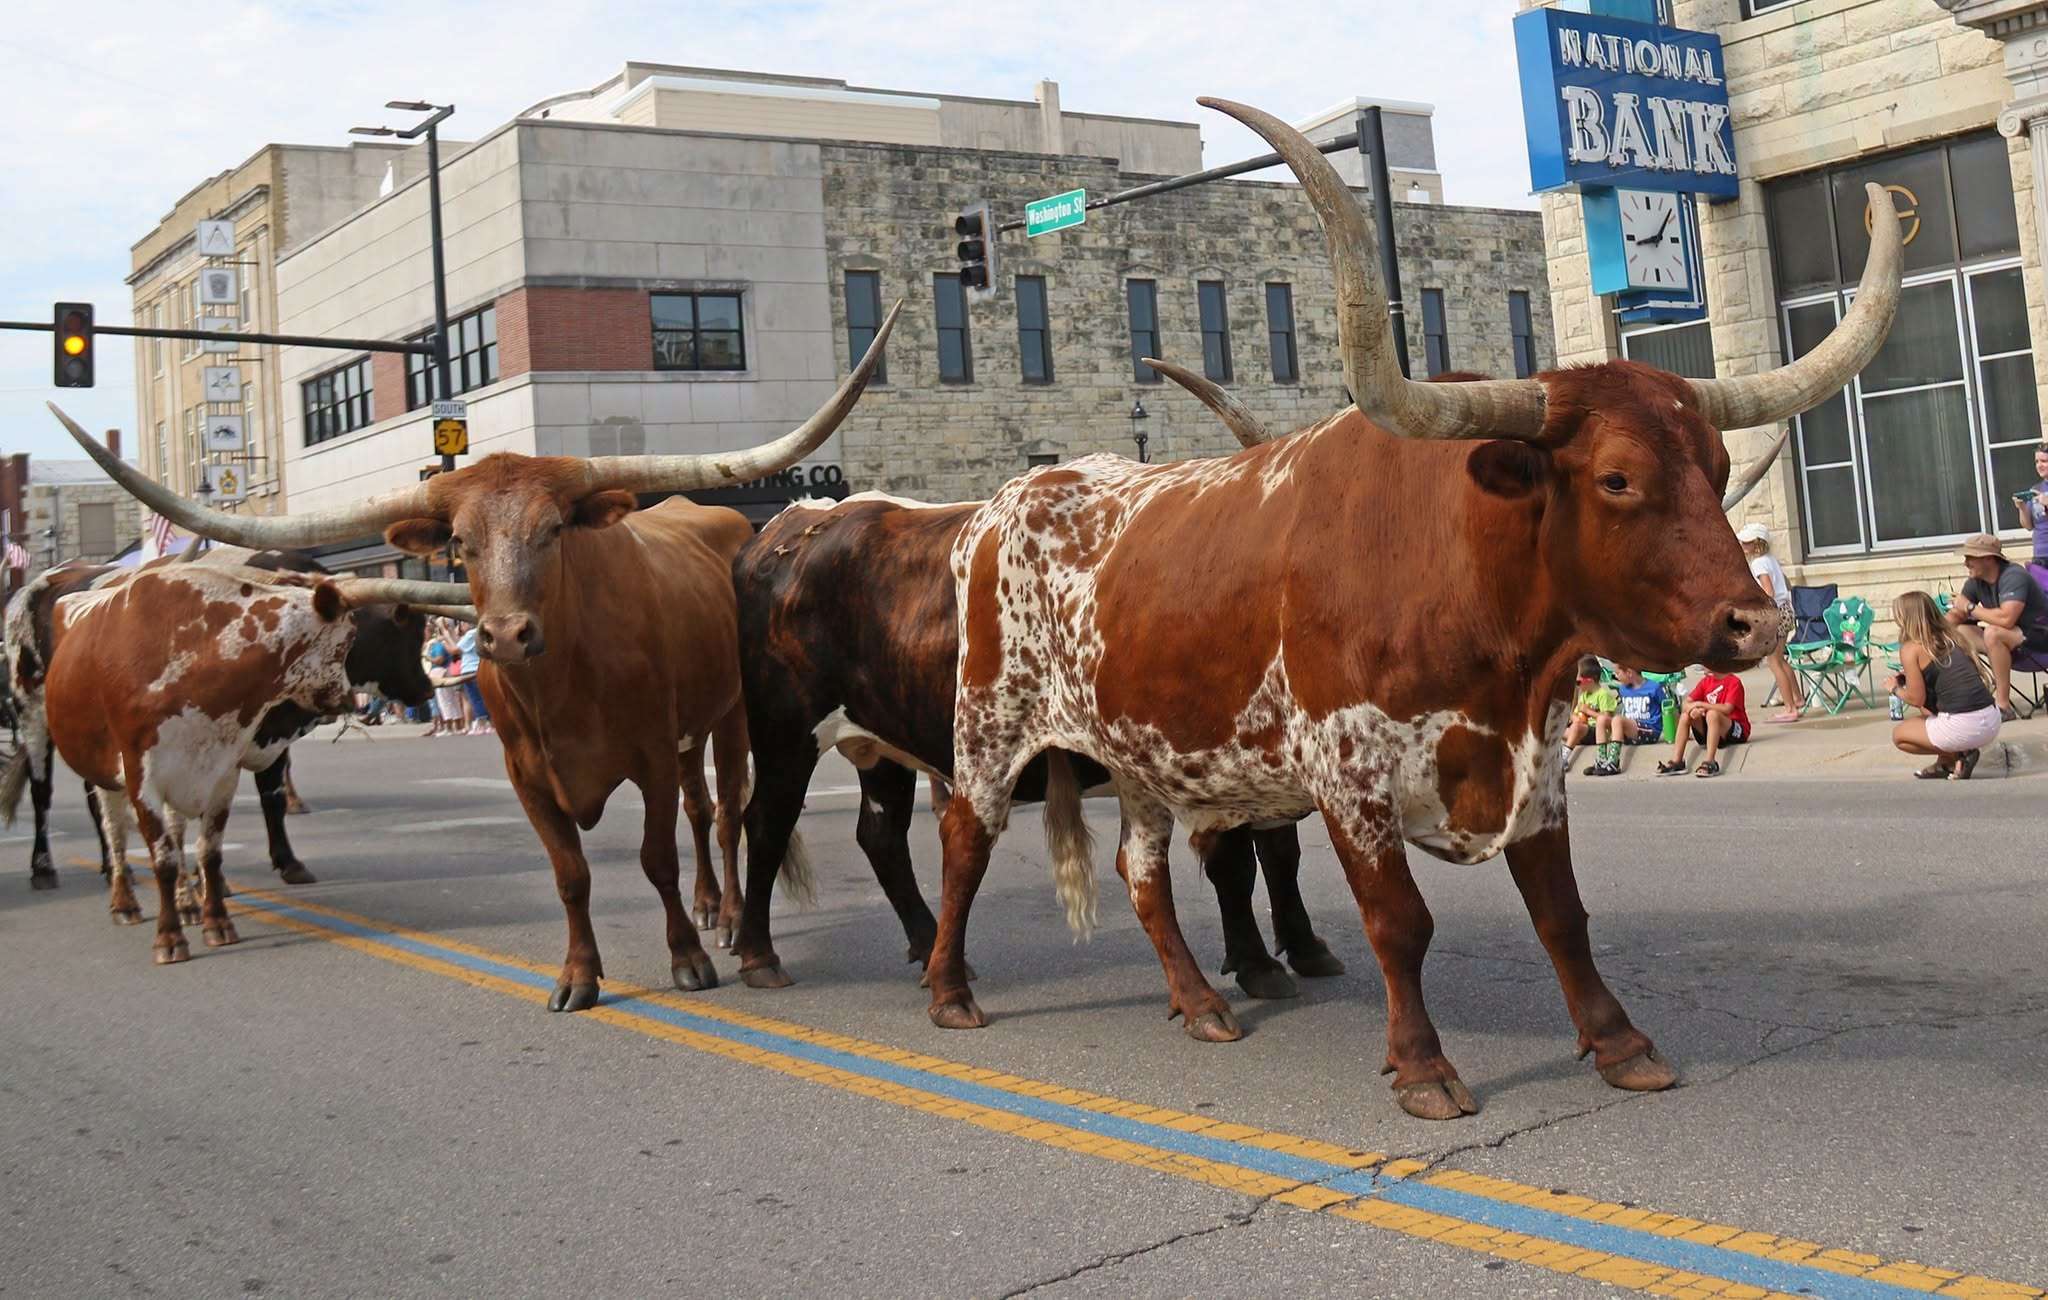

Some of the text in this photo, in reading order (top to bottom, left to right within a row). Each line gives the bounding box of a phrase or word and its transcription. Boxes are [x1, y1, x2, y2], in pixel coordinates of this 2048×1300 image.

[1558, 27, 1723, 86] NATIONAL
[1561, 85, 1737, 175] BANK
[1028, 196, 1083, 226] Washington St
[434, 403, 465, 415] SOUTH
[438, 428, 463, 447] 57
